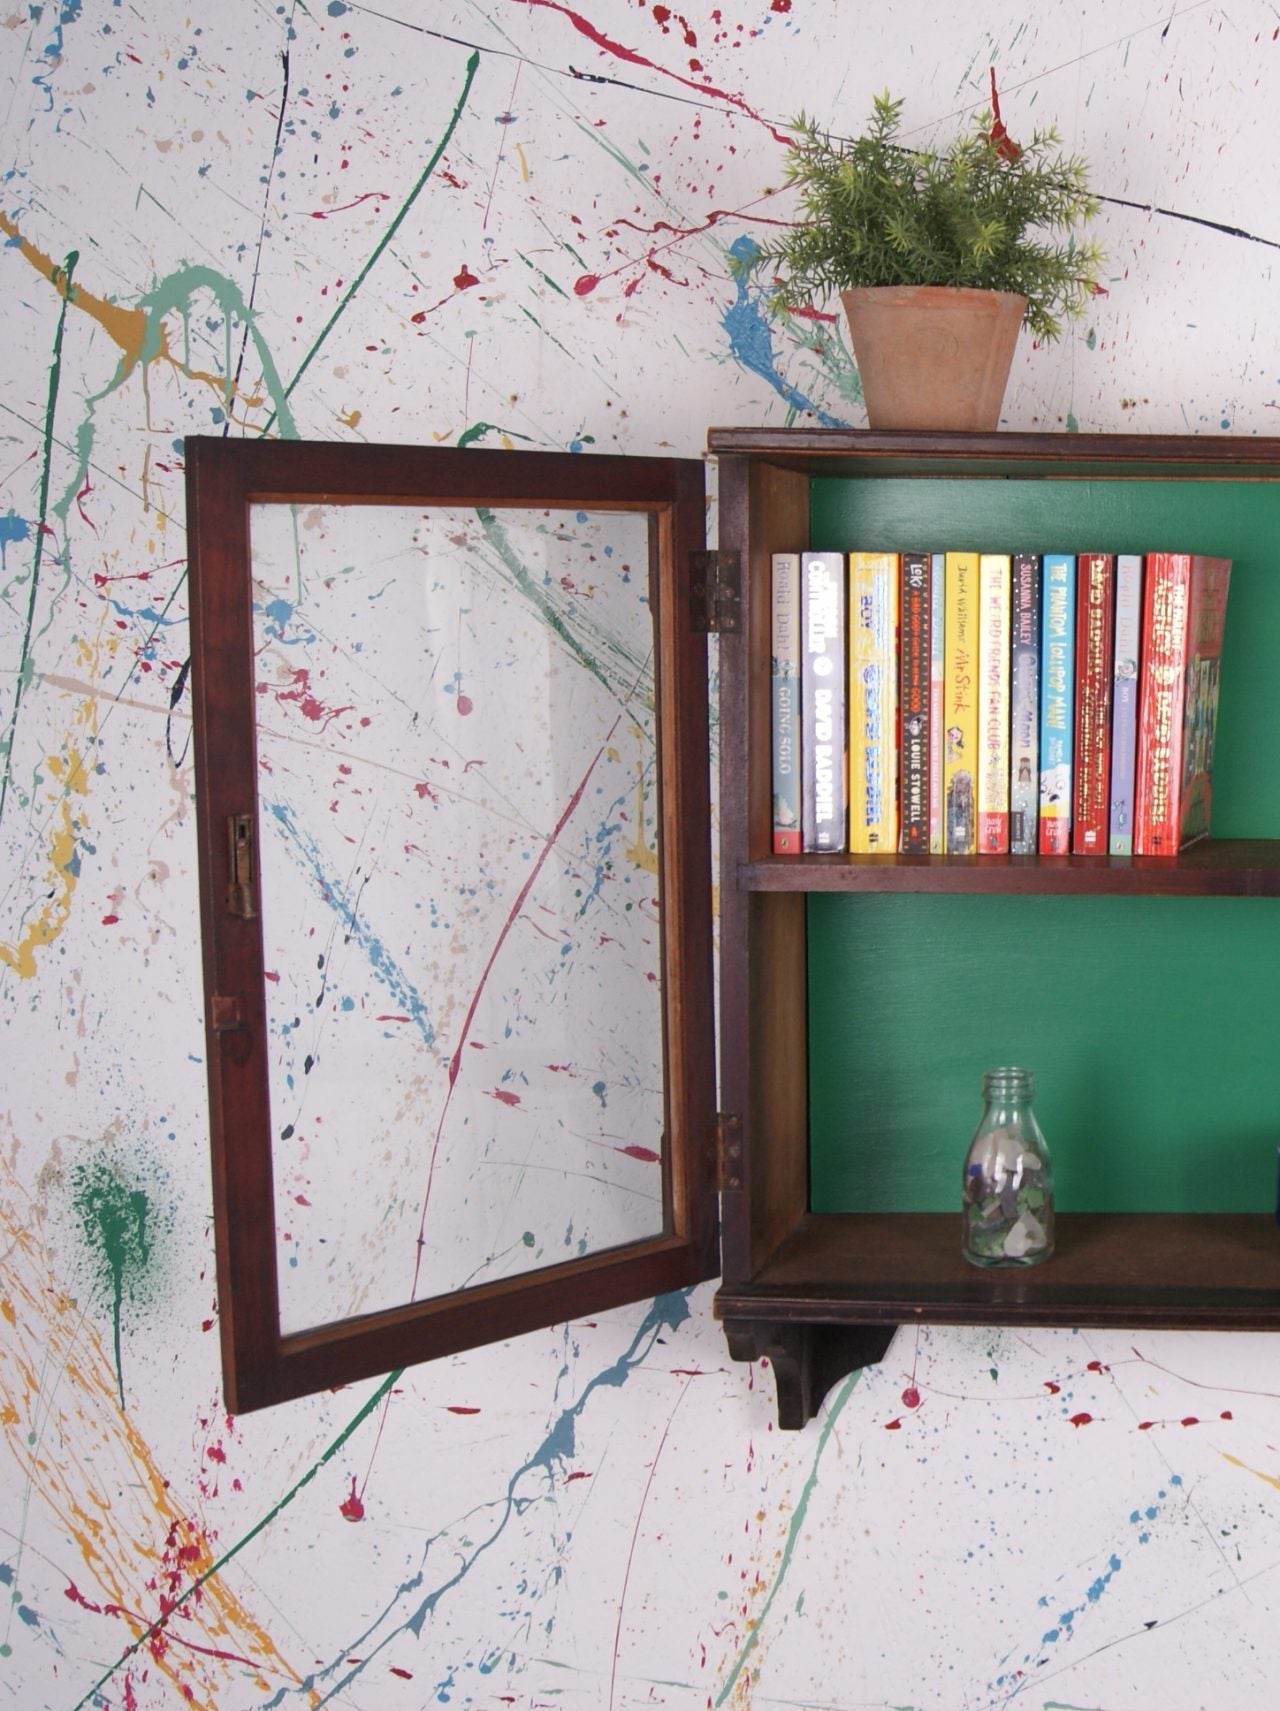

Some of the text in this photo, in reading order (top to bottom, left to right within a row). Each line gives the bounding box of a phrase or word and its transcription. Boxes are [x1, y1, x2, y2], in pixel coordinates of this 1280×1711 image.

[958, 565, 968, 593] David
[989, 569, 1003, 590] THE
[1049, 562, 1068, 583] THE
[776, 561, 791, 651] Roald Dahl
[988, 596, 1002, 638] WEIRD
[1020, 563, 1032, 646] SUSANNA BAILEY
[1049, 586, 1069, 638] PHANTOM
[1087, 560, 1105, 676] DAVID BADDIEL
[1150, 577, 1174, 656] AGENCY
[1171, 584, 1185, 650] THE PARENT
[953, 648, 971, 715] Mr Stink
[988, 640, 1002, 686] FRIENDS
[1048, 643, 1067, 693] LOLLIPOP
[911, 687, 921, 713] GOOD
[987, 690, 1001, 714] FAN
[1045, 694, 1068, 730] MAN!
[779, 687, 791, 774] GOING SOLO
[987, 718, 1001, 750] CLUB
[1020, 710, 1033, 748] Moon
[815, 689, 833, 823] DAVID BADDIEL
[910, 738, 921, 823] LOUIE STOWELL
[1150, 690, 1173, 826] DAVID BADDIEL
